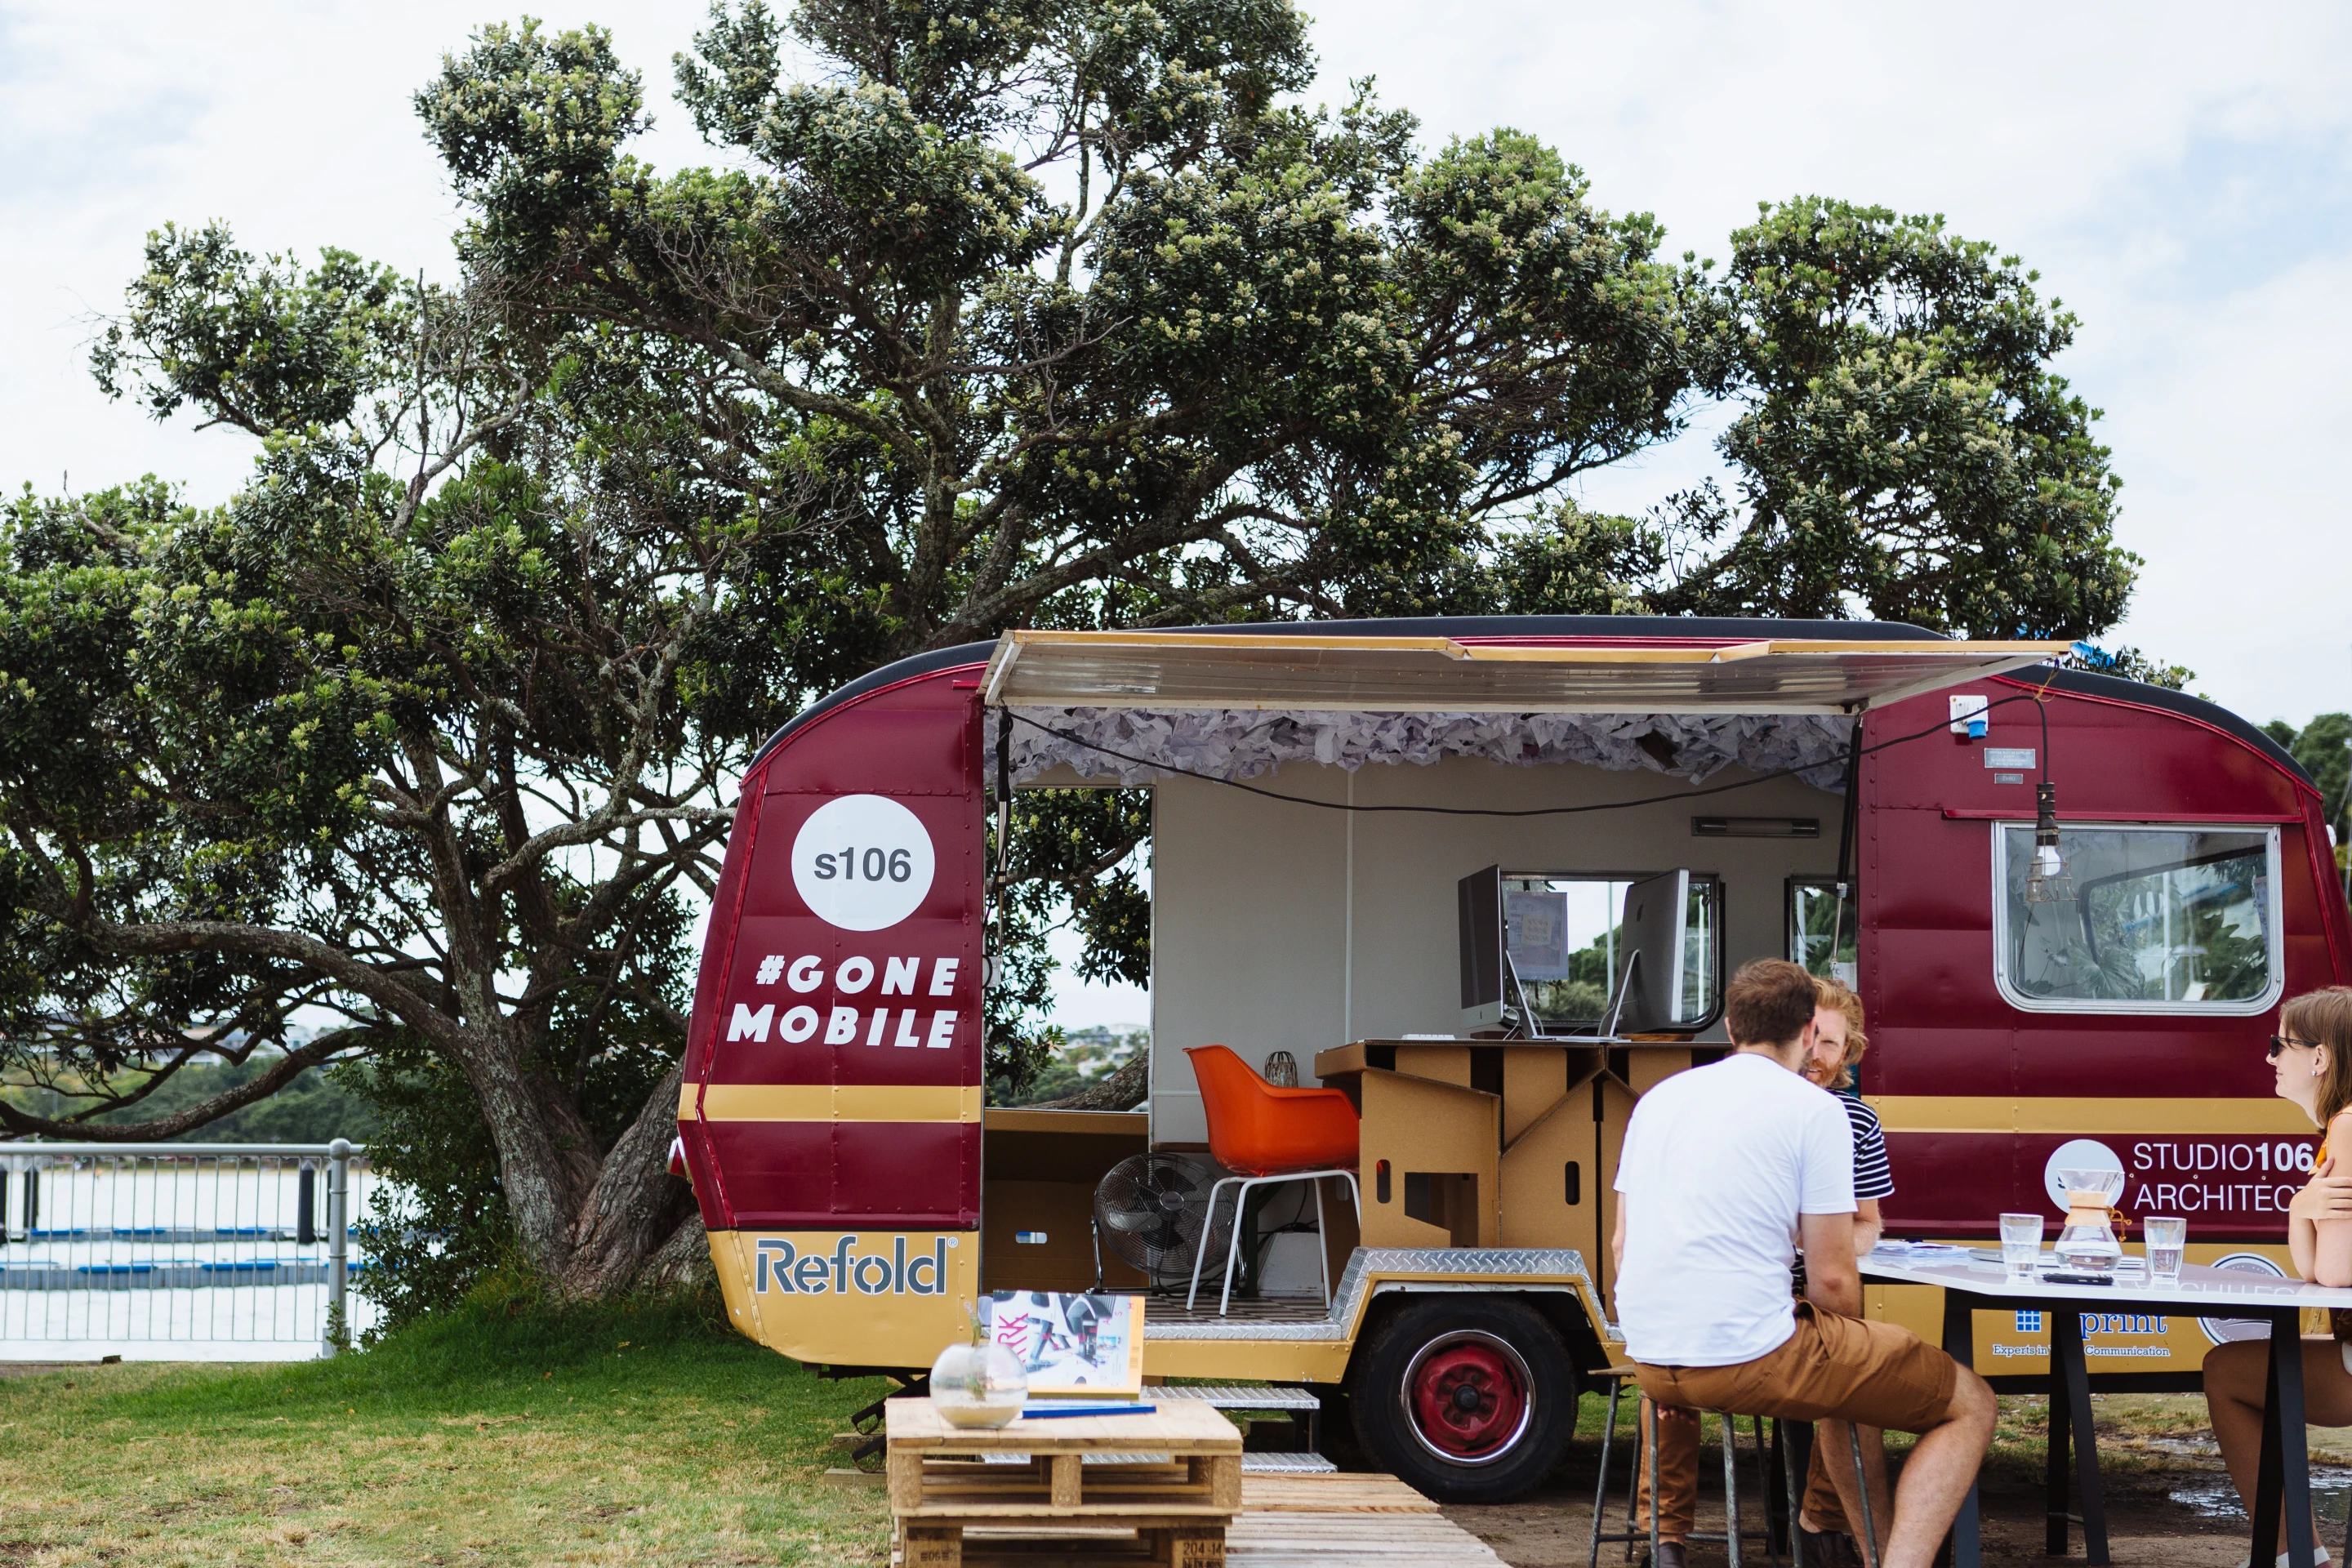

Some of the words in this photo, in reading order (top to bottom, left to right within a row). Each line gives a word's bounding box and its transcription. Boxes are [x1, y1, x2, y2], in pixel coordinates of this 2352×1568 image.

[814, 846, 911, 883] s106
[755, 954, 960, 996] #GONE
[726, 1003, 959, 1049] MOBILE
[2133, 1143, 2314, 1172] STUDIO106
[2134, 1183, 2306, 1213] ARCHITEC
[1993, 1344, 2035, 1357] Experts
[2036, 1344, 2049, 1356] in
[2084, 1345, 2171, 1356] Communication
